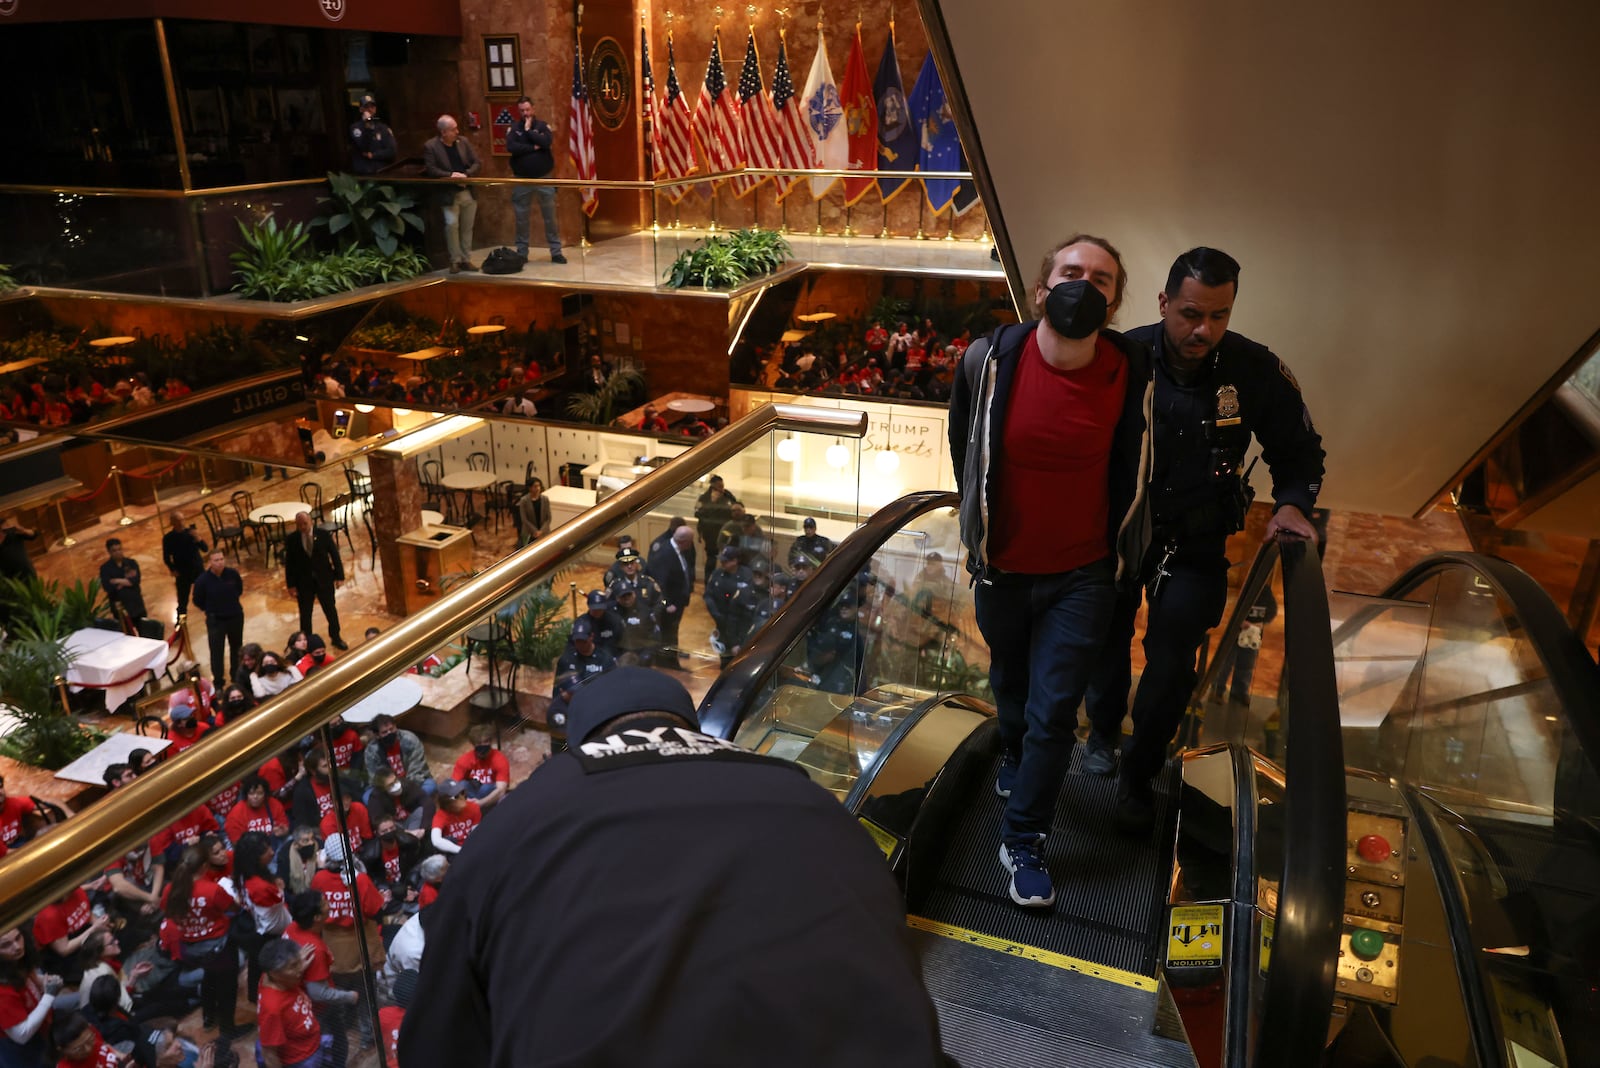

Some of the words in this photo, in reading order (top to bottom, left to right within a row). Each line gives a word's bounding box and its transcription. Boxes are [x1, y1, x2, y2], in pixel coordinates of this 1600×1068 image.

[601, 68, 621, 100] 45
[869, 421, 929, 436] TRUMP
[325, 891, 351, 901] TOP
[1173, 959, 1215, 967] CAUTION
